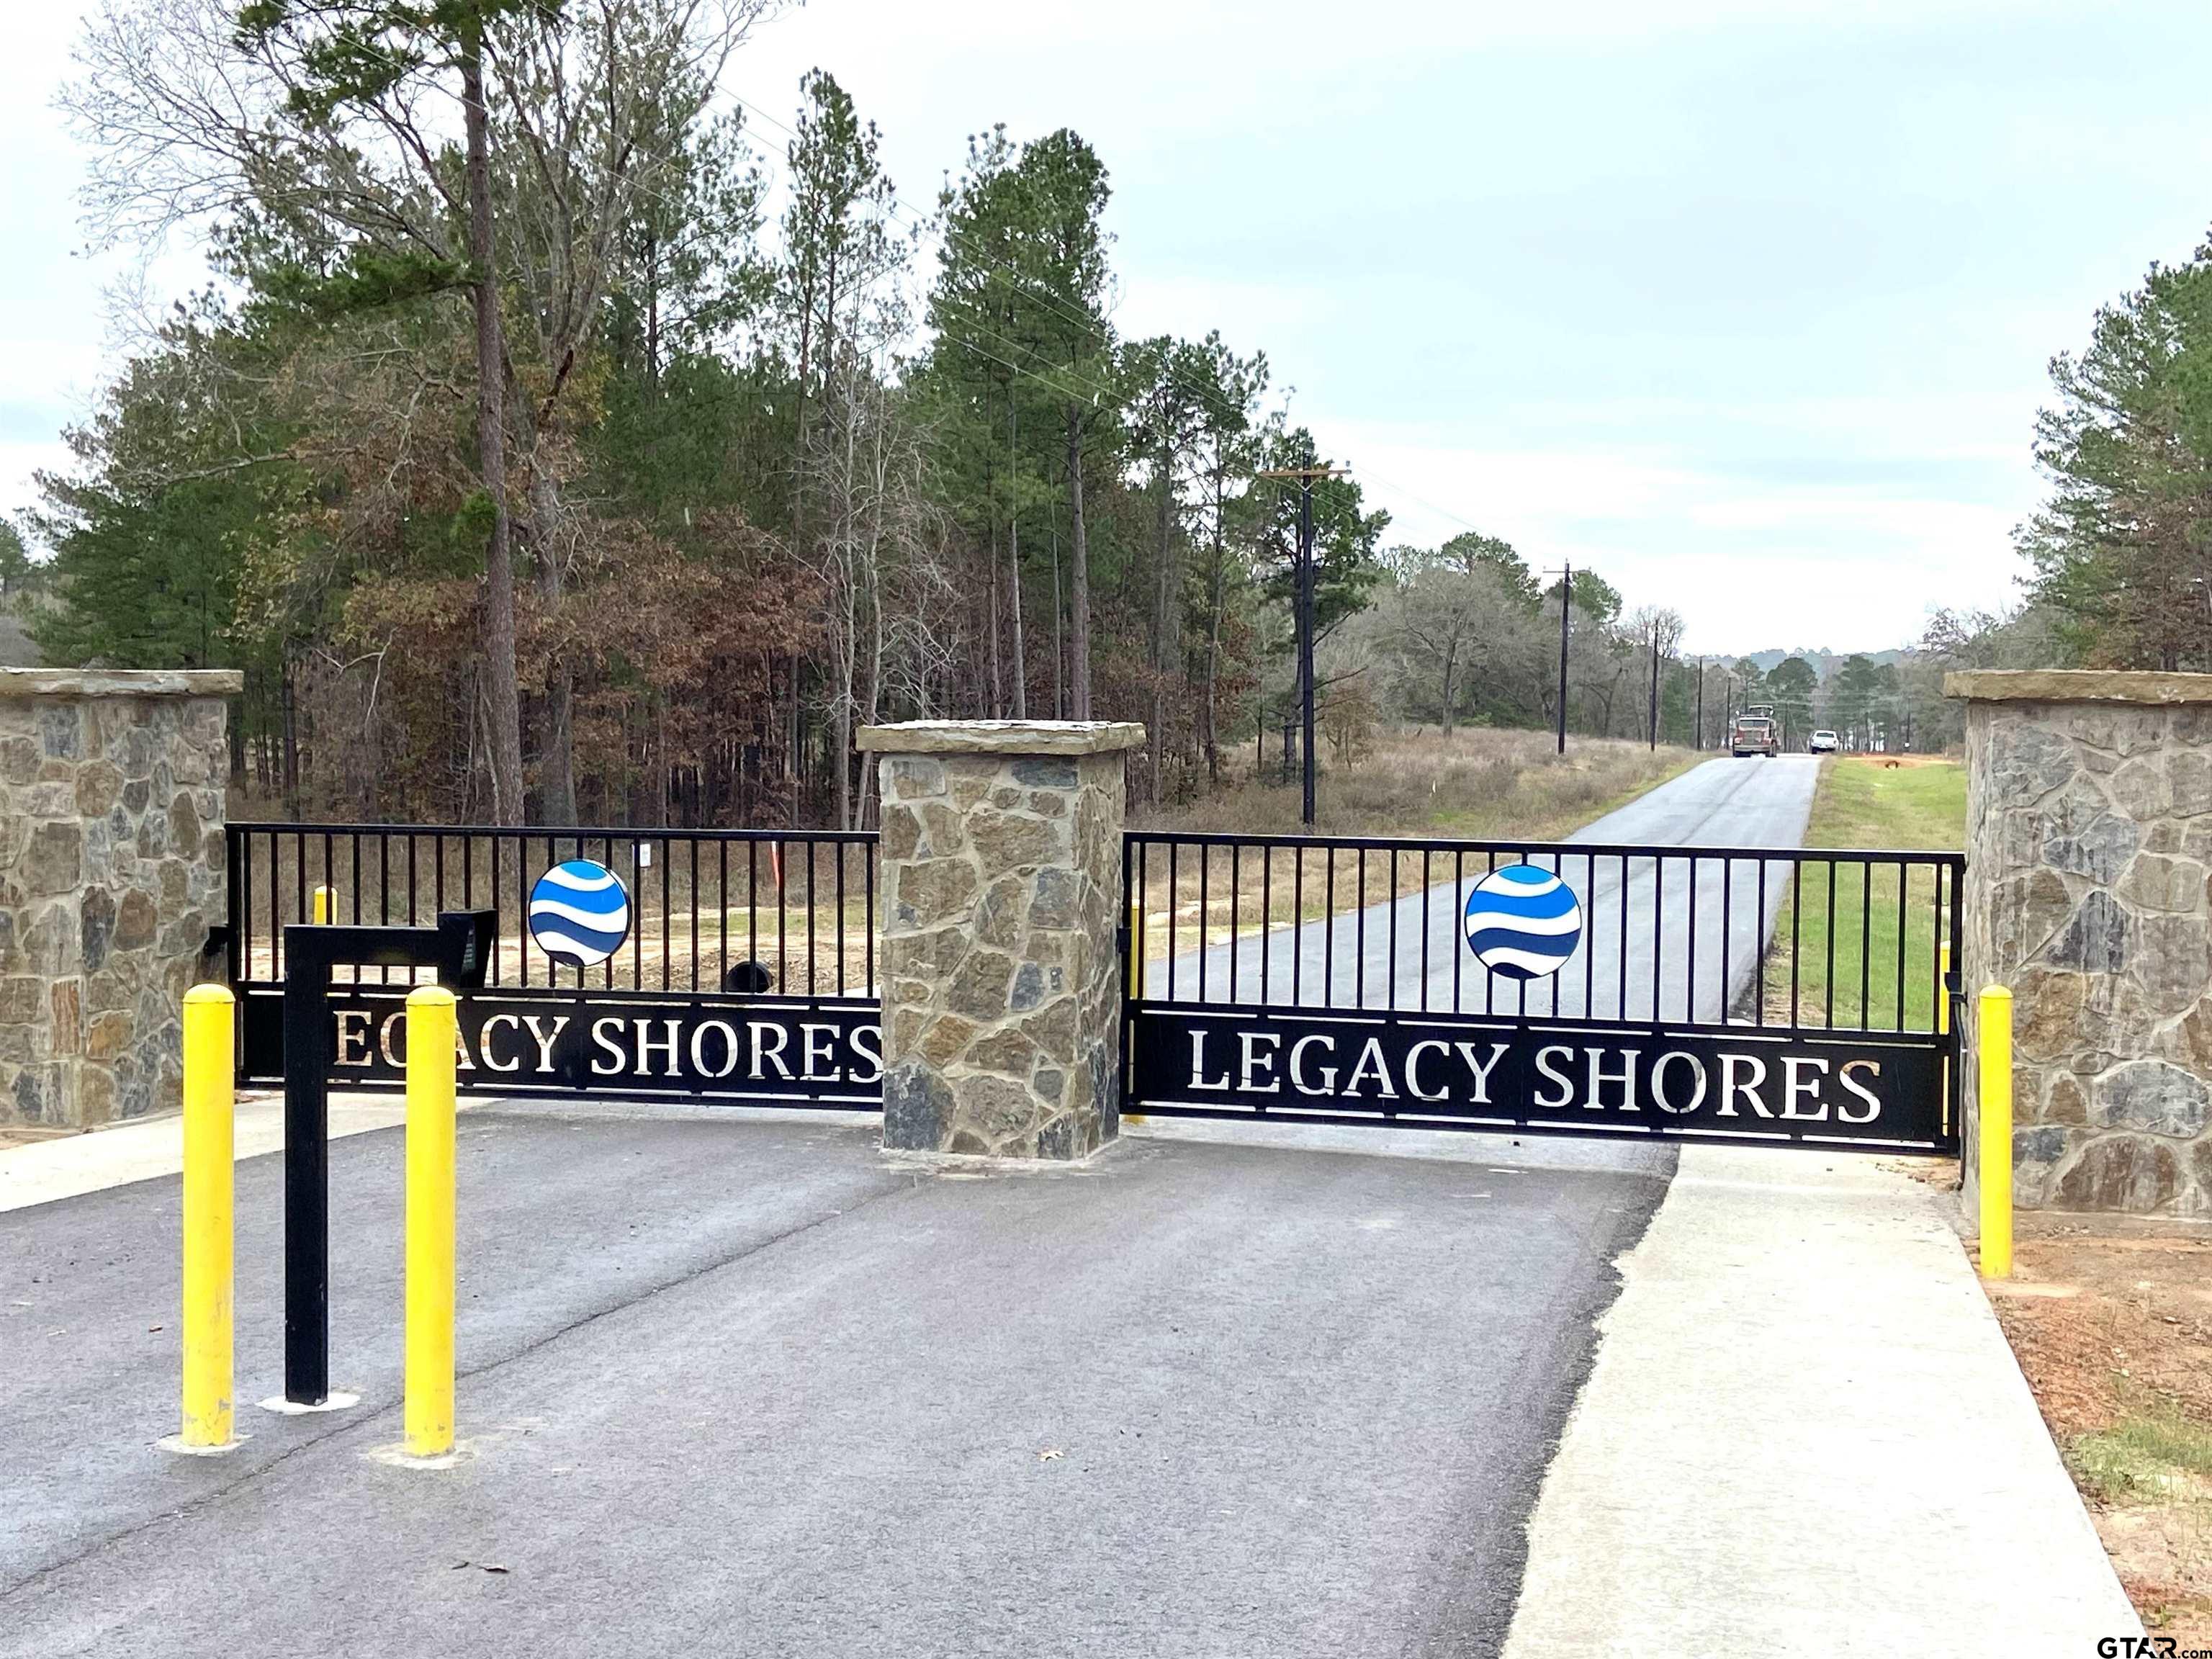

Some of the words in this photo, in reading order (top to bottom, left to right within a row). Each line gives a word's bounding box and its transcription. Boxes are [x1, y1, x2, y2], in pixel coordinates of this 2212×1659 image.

[332, 1010, 570, 1072] EGCY
[590, 1017, 883, 1082] SHORES
[1188, 1030, 1509, 1104] LEGACY
[1533, 1046, 1881, 1123] SHORES
